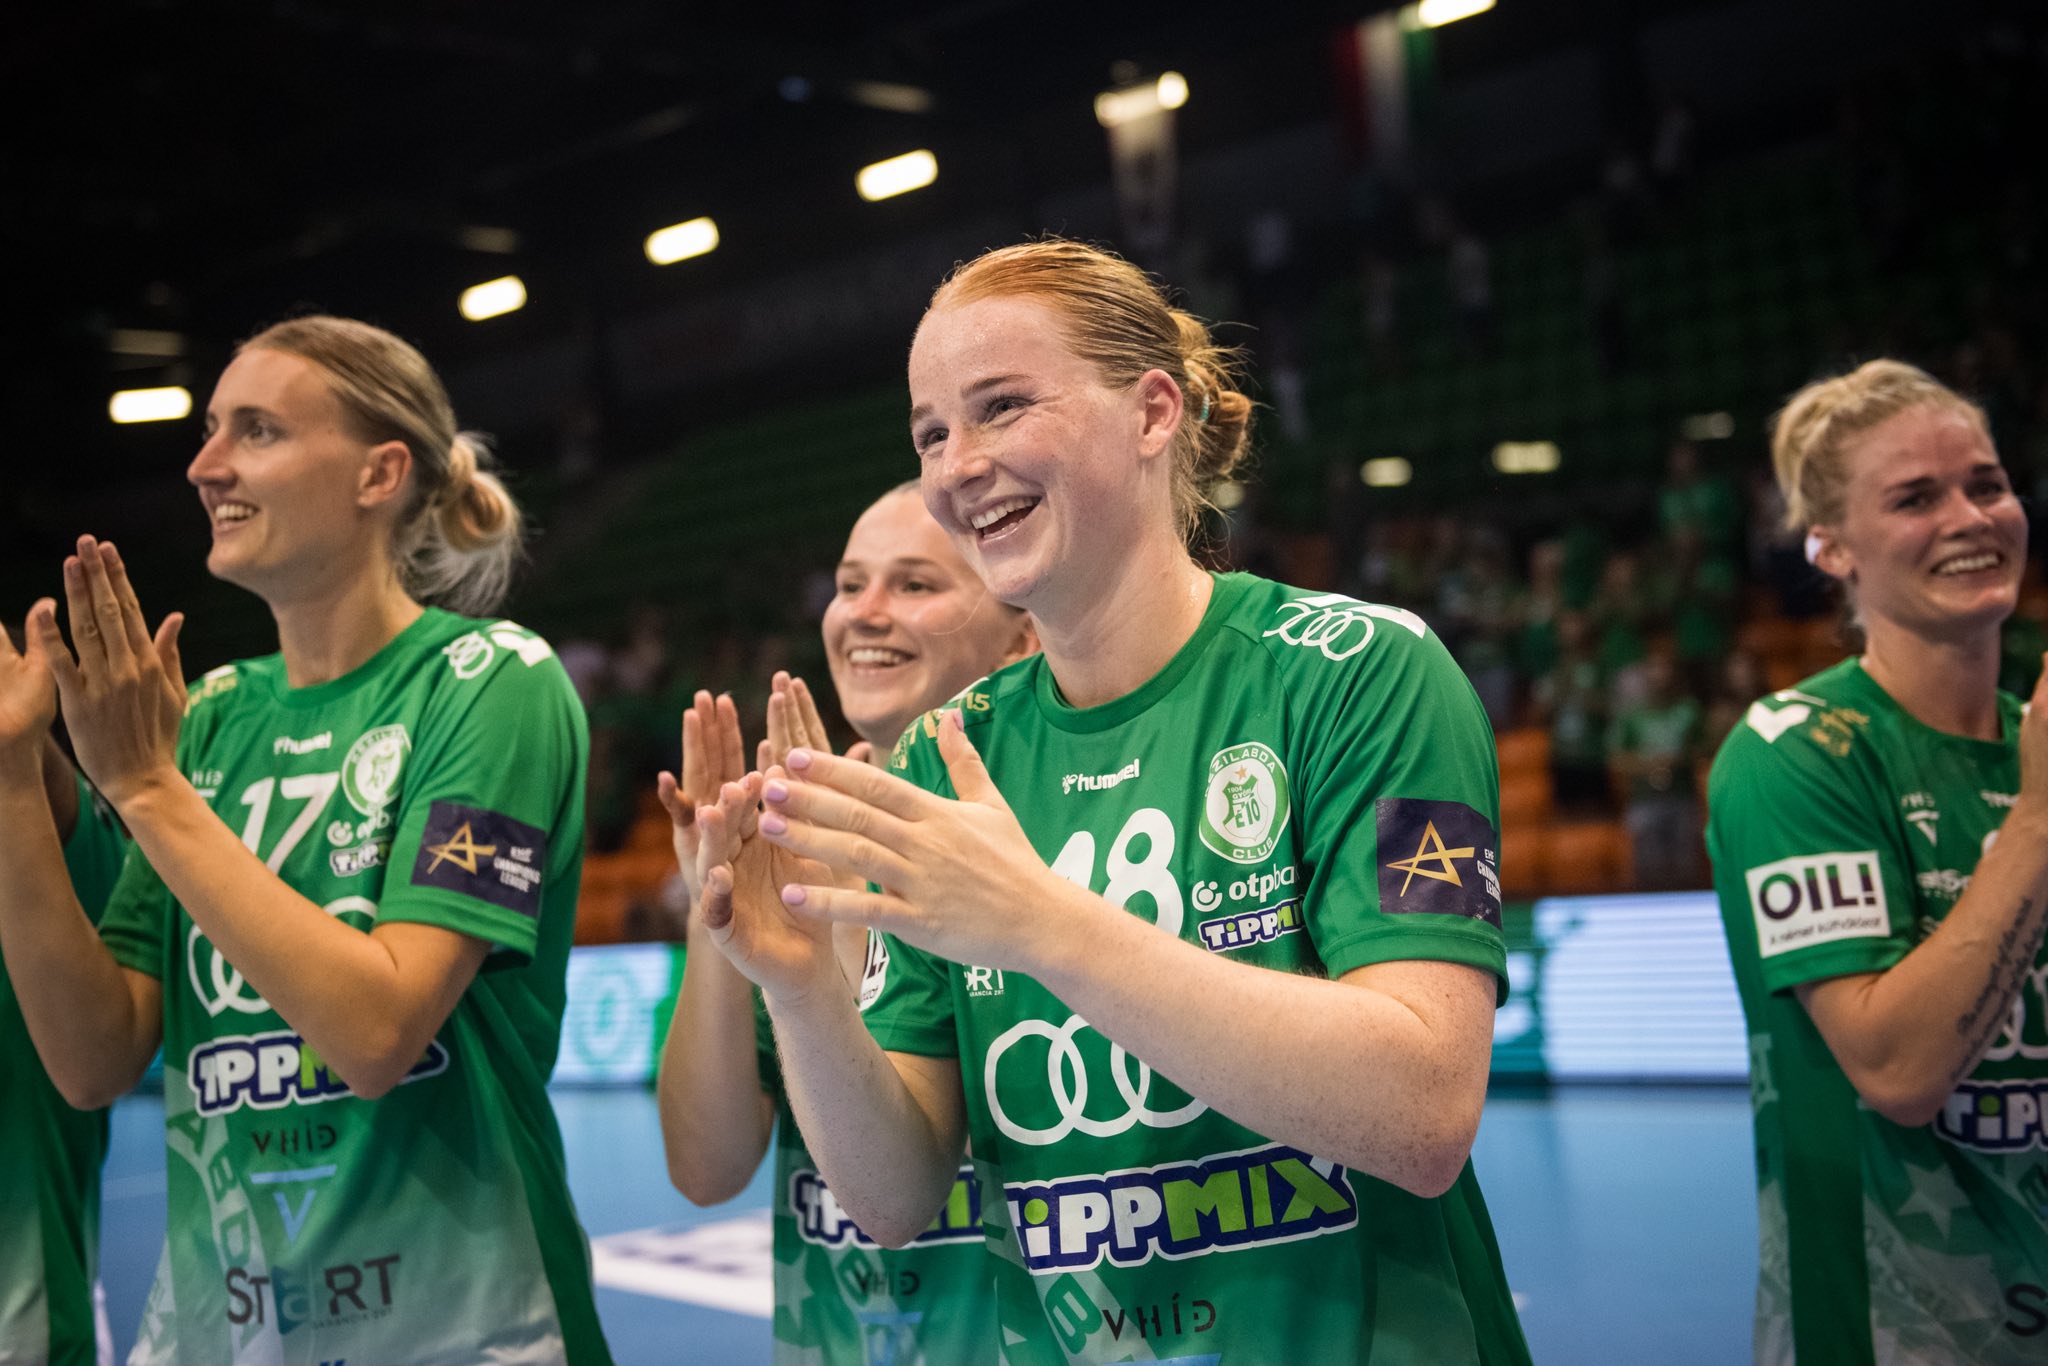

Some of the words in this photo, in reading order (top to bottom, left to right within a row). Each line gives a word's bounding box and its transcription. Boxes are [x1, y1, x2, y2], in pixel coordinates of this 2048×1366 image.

[1208, 747, 1277, 784] ZILABDA
[240, 771, 340, 877] 17
[1759, 863, 1879, 921] OIL!
